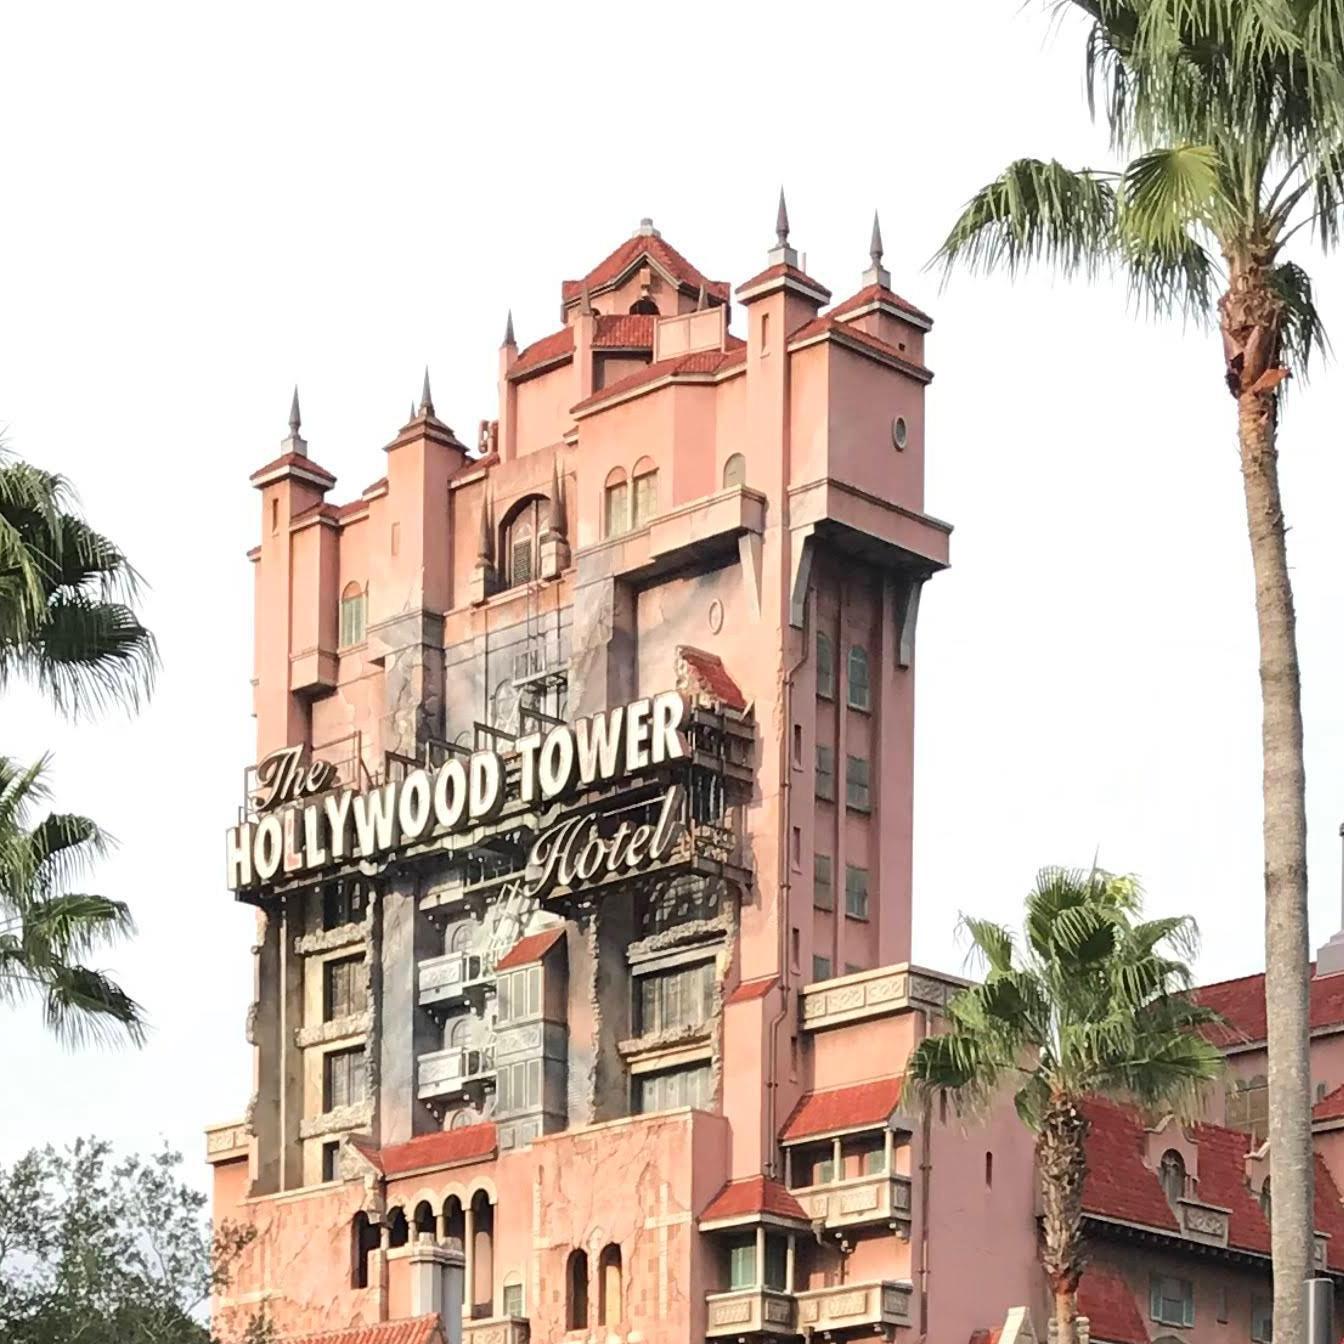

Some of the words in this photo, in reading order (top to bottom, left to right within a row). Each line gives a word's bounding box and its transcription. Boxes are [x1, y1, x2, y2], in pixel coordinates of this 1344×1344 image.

[226, 748, 500, 891] HOLLYWOOD
[514, 689, 685, 802] TOWER
[251, 743, 331, 812] The
[524, 784, 680, 898] Hotel
